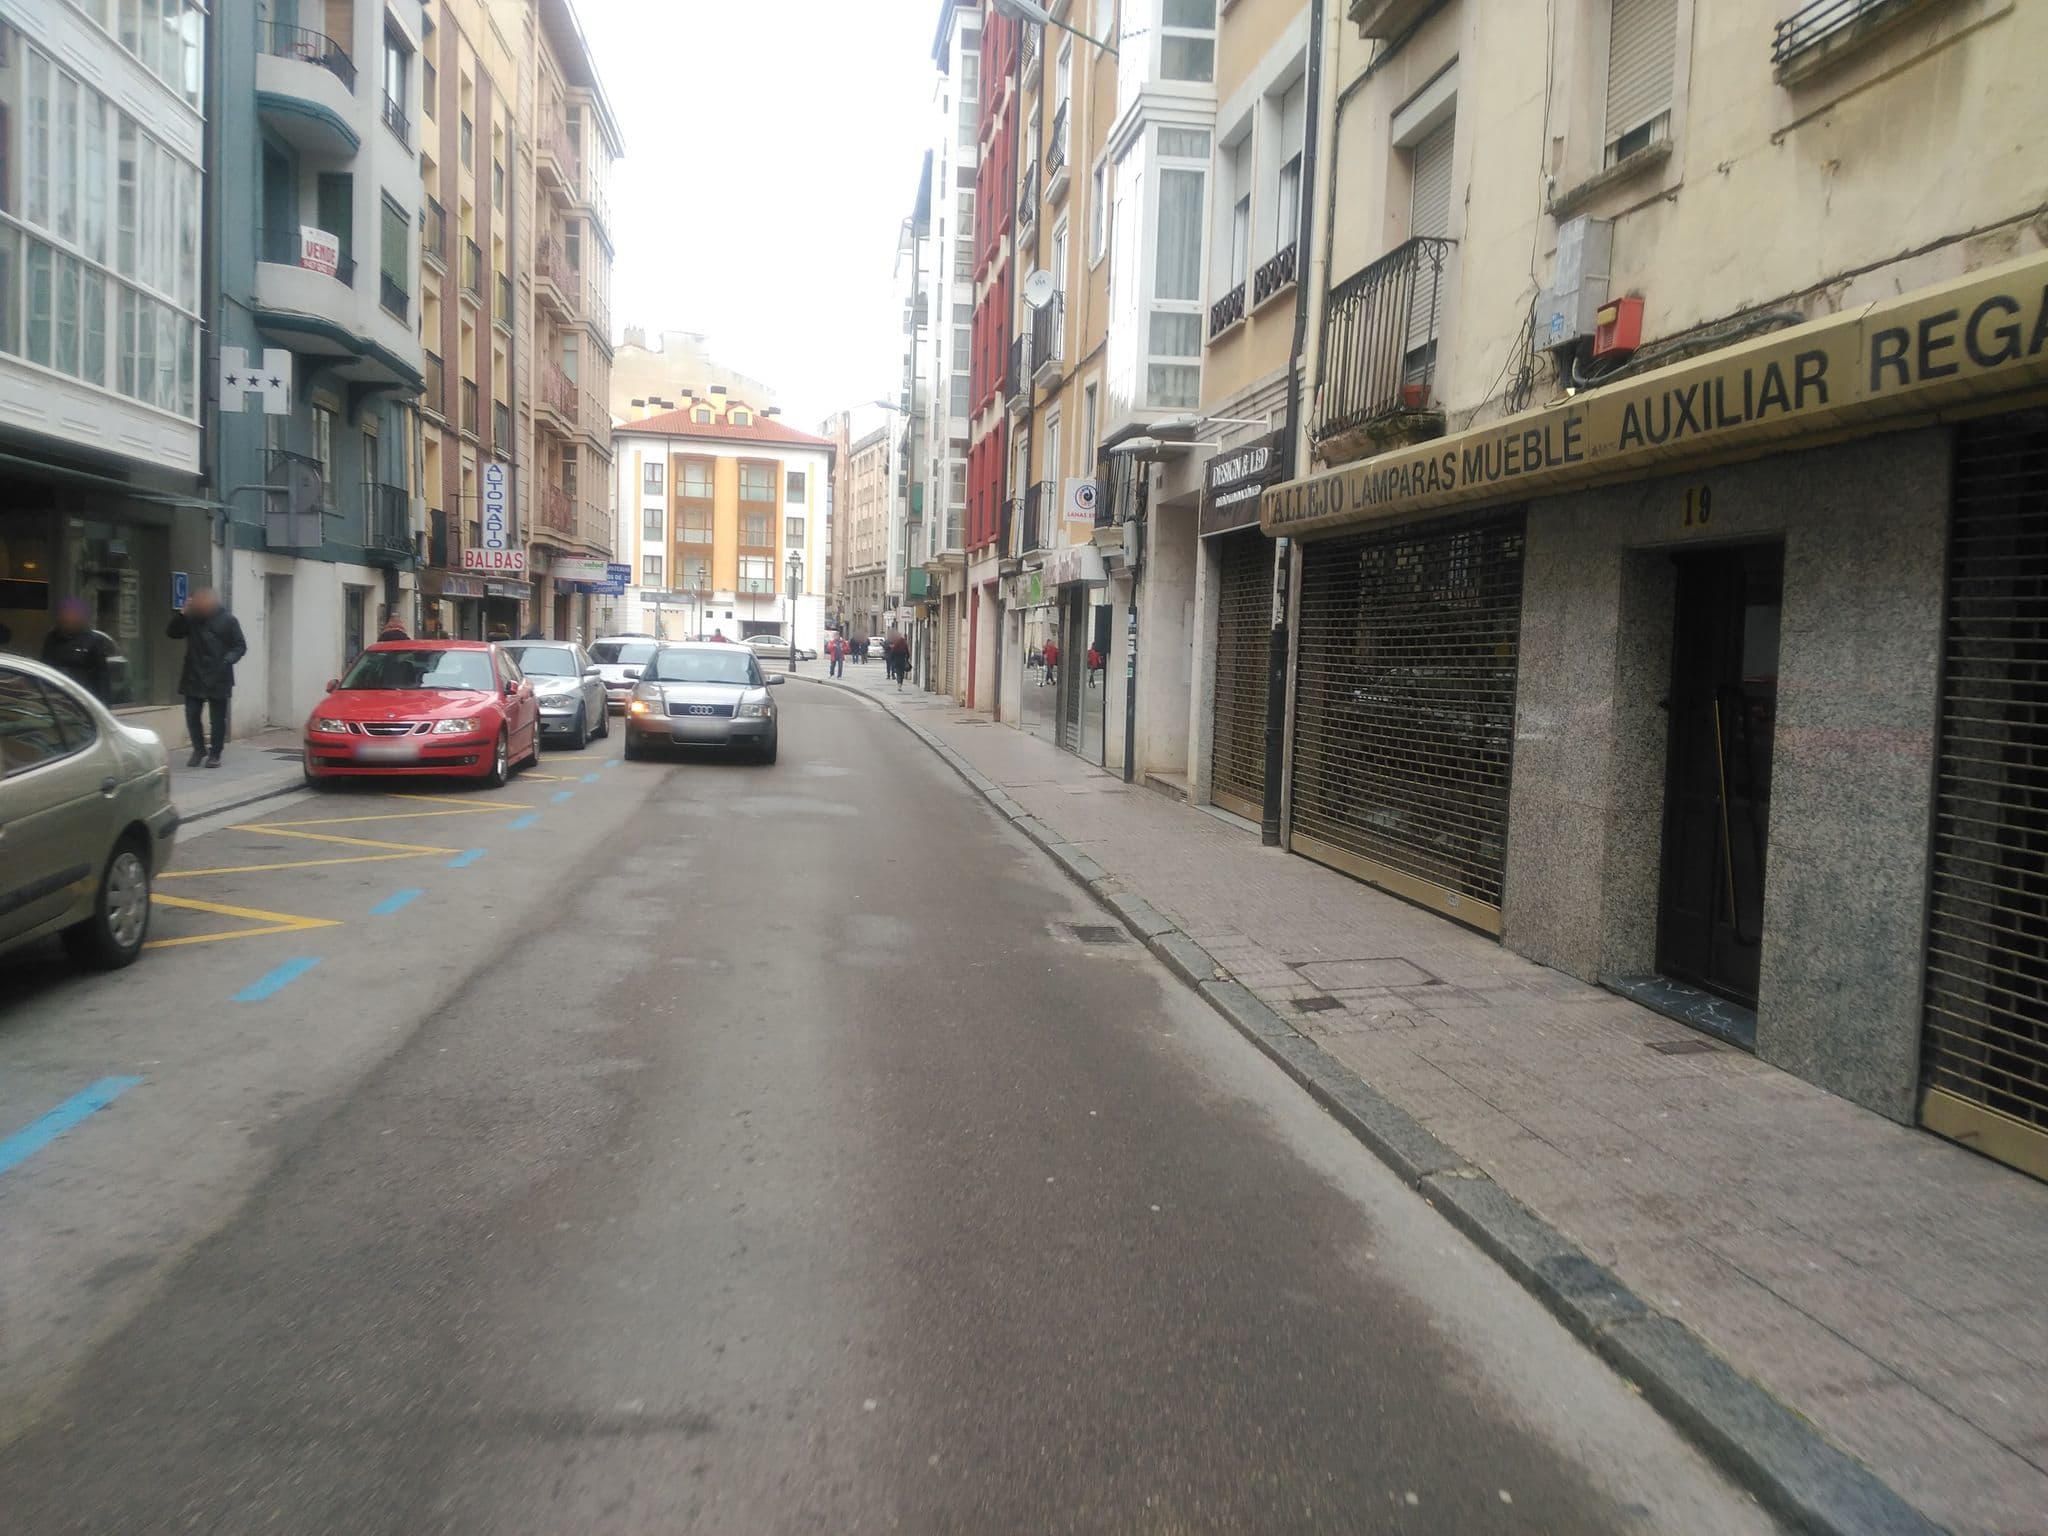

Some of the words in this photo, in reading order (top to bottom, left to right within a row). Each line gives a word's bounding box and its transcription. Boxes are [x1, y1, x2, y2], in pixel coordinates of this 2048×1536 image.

[1266, 476, 1343, 525] VALLEJO
[1353, 451, 1456, 508] LAMPARAS
[1463, 417, 1584, 485] MUEBLE
[1619, 349, 1828, 449] AUXILIAR
[1249, 447, 1269, 473] LED
[487, 464, 503, 500] AUTO
[1684, 487, 1711, 526] 19
[487, 505, 503, 549] RADIO
[465, 551, 523, 569] BALBAS
